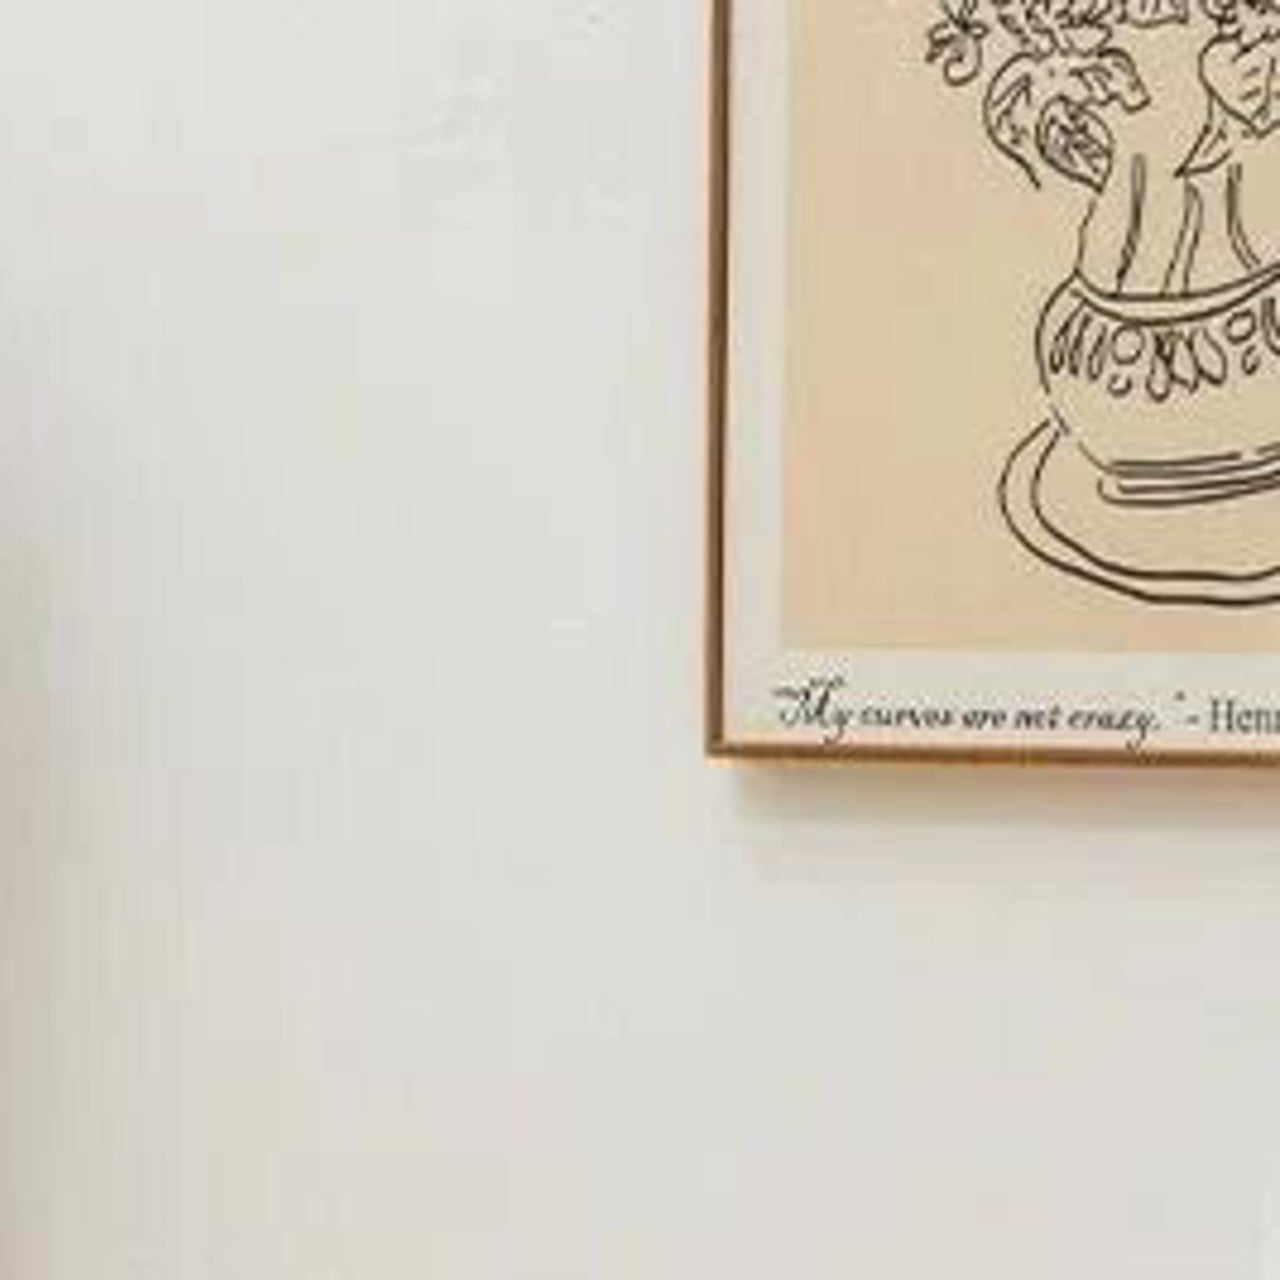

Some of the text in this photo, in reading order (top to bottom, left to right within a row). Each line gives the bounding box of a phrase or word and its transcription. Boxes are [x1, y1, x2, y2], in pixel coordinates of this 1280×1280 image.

[861, 706, 953, 728] curves
[963, 708, 1007, 729] are
[1015, 705, 1061, 730] not
